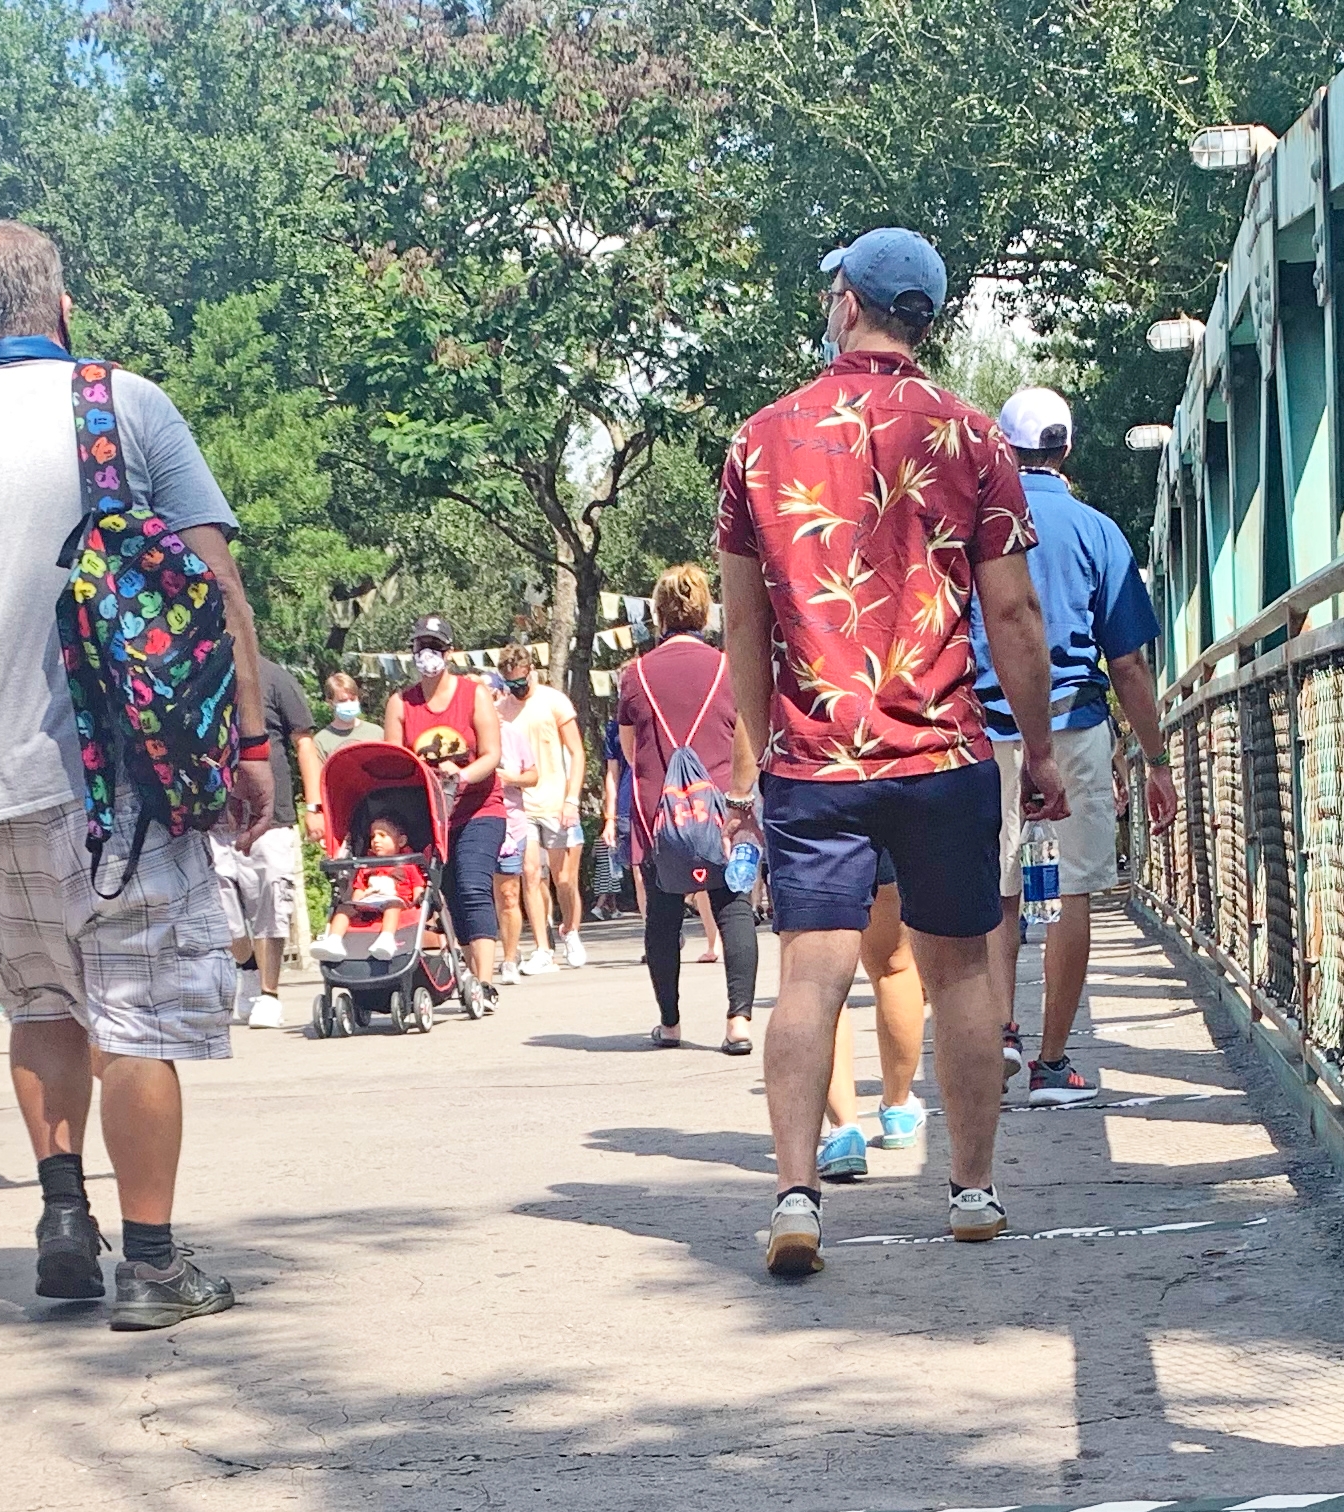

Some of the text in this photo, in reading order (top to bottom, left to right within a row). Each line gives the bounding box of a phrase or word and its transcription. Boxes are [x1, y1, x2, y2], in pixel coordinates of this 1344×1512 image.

[785, 1197, 808, 1208] NIKE
[961, 1192, 982, 1203] NIKE
[882, 1229, 1160, 1245] PLEA WAIT HERE
